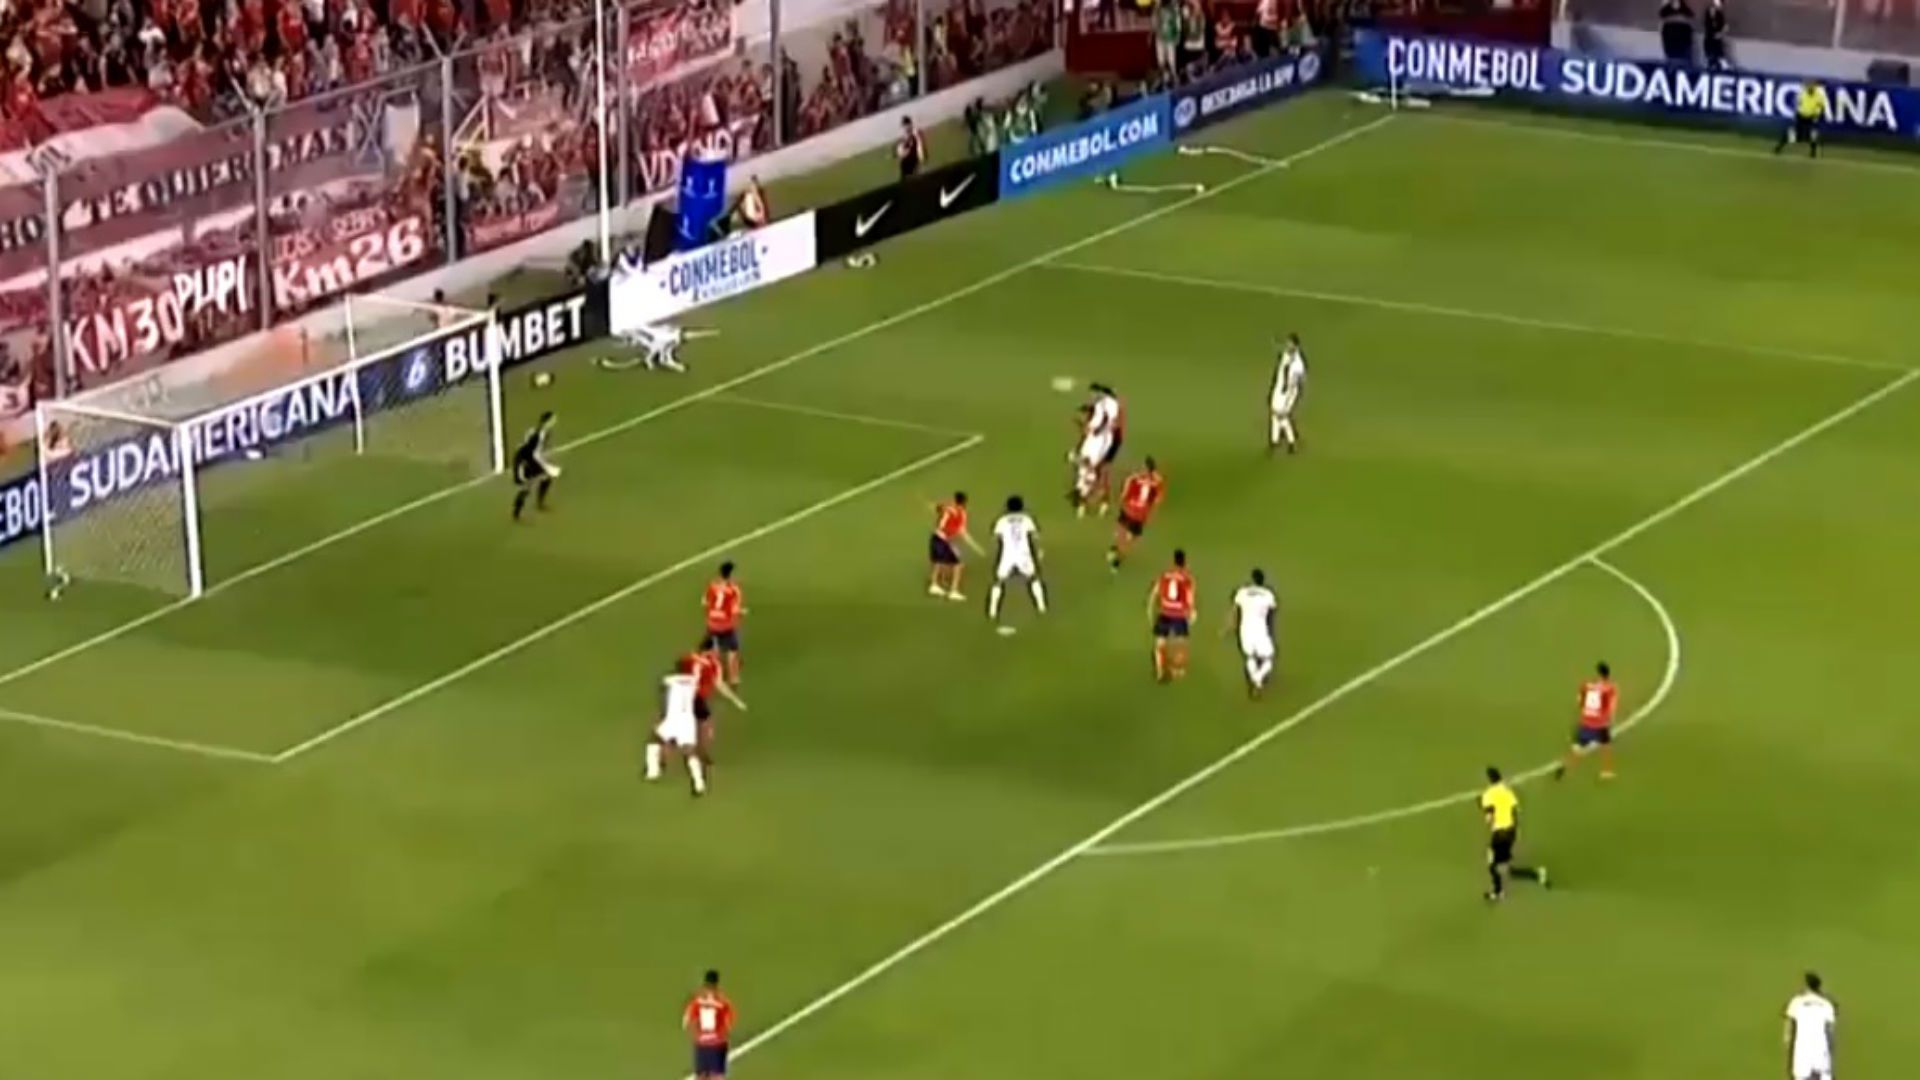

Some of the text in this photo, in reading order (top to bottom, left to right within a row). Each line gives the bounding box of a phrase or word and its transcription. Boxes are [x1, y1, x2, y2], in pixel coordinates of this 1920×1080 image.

[1388, 37, 1545, 92] CONMEBOL
[1010, 112, 1159, 184] CONMEBOL.COM
[669, 239, 760, 296] CONMEBOL
[63, 290, 185, 377] KM30
[445, 294, 587, 383] BUMBET
[70, 371, 356, 508] SUDAMERICANA
